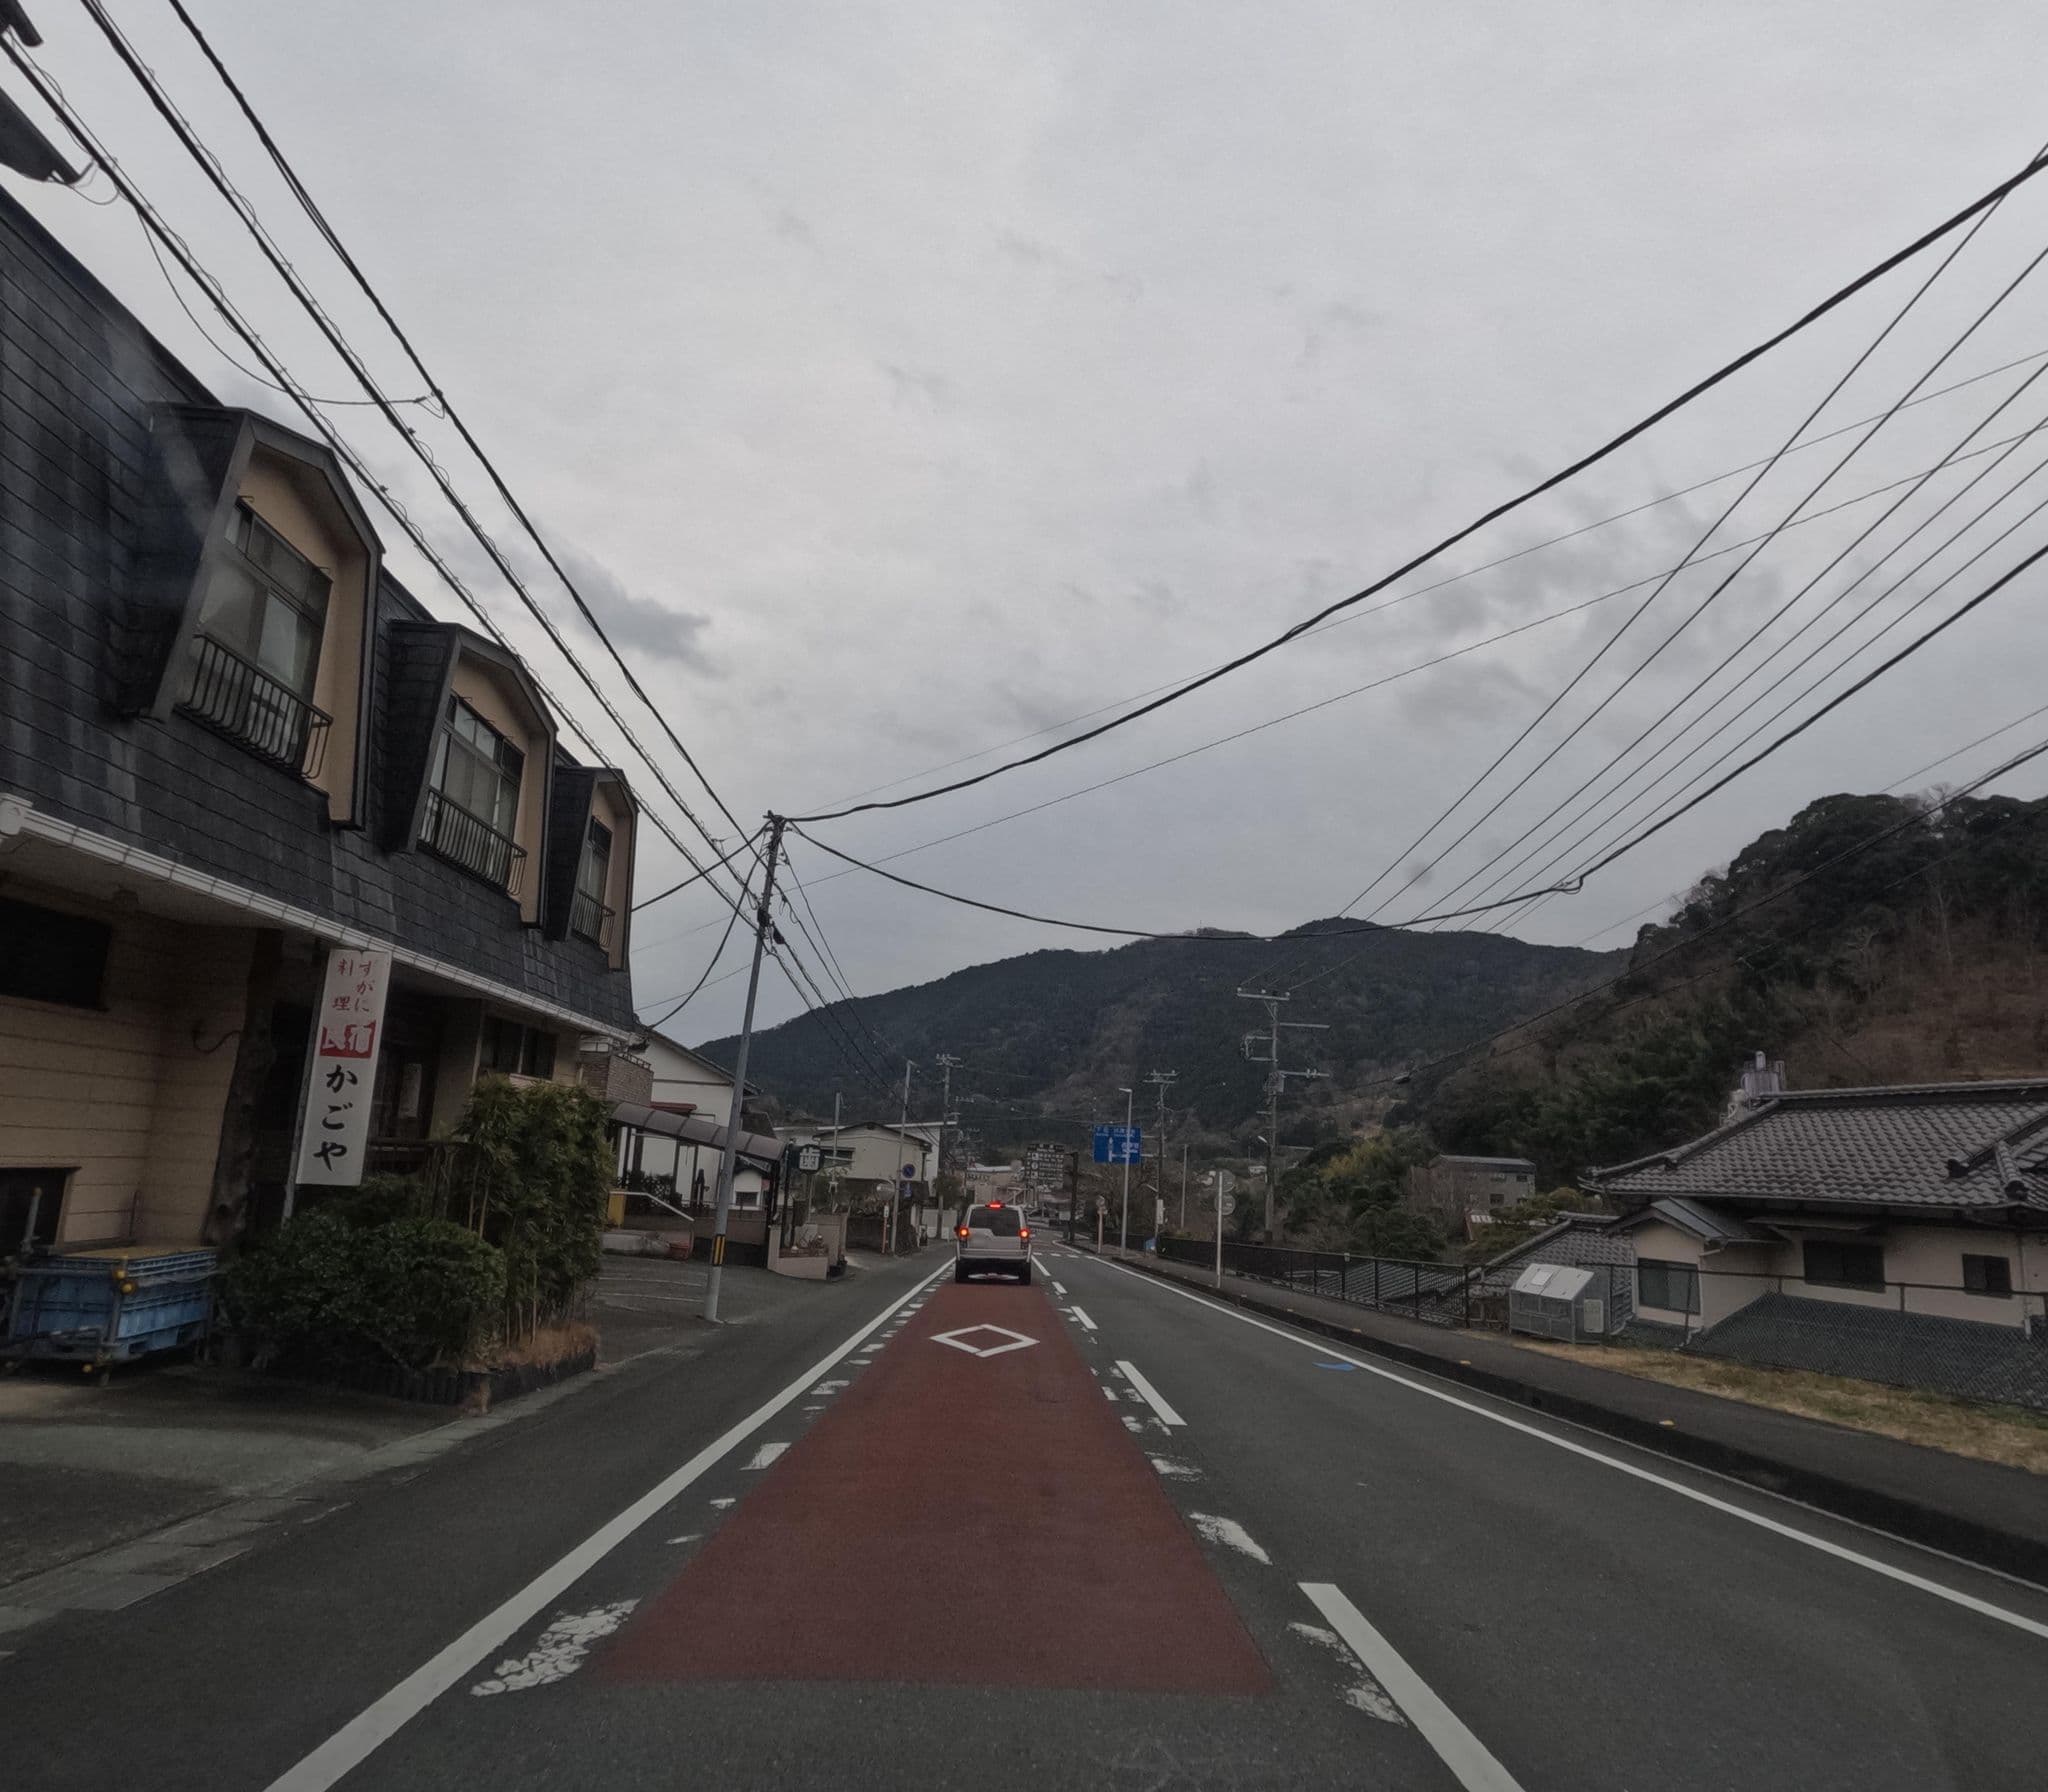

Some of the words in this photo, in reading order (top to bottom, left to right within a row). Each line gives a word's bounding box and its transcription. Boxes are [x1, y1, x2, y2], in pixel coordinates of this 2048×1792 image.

[331, 958, 354, 1012] 料理
[313, 1064, 358, 1172] かごや
